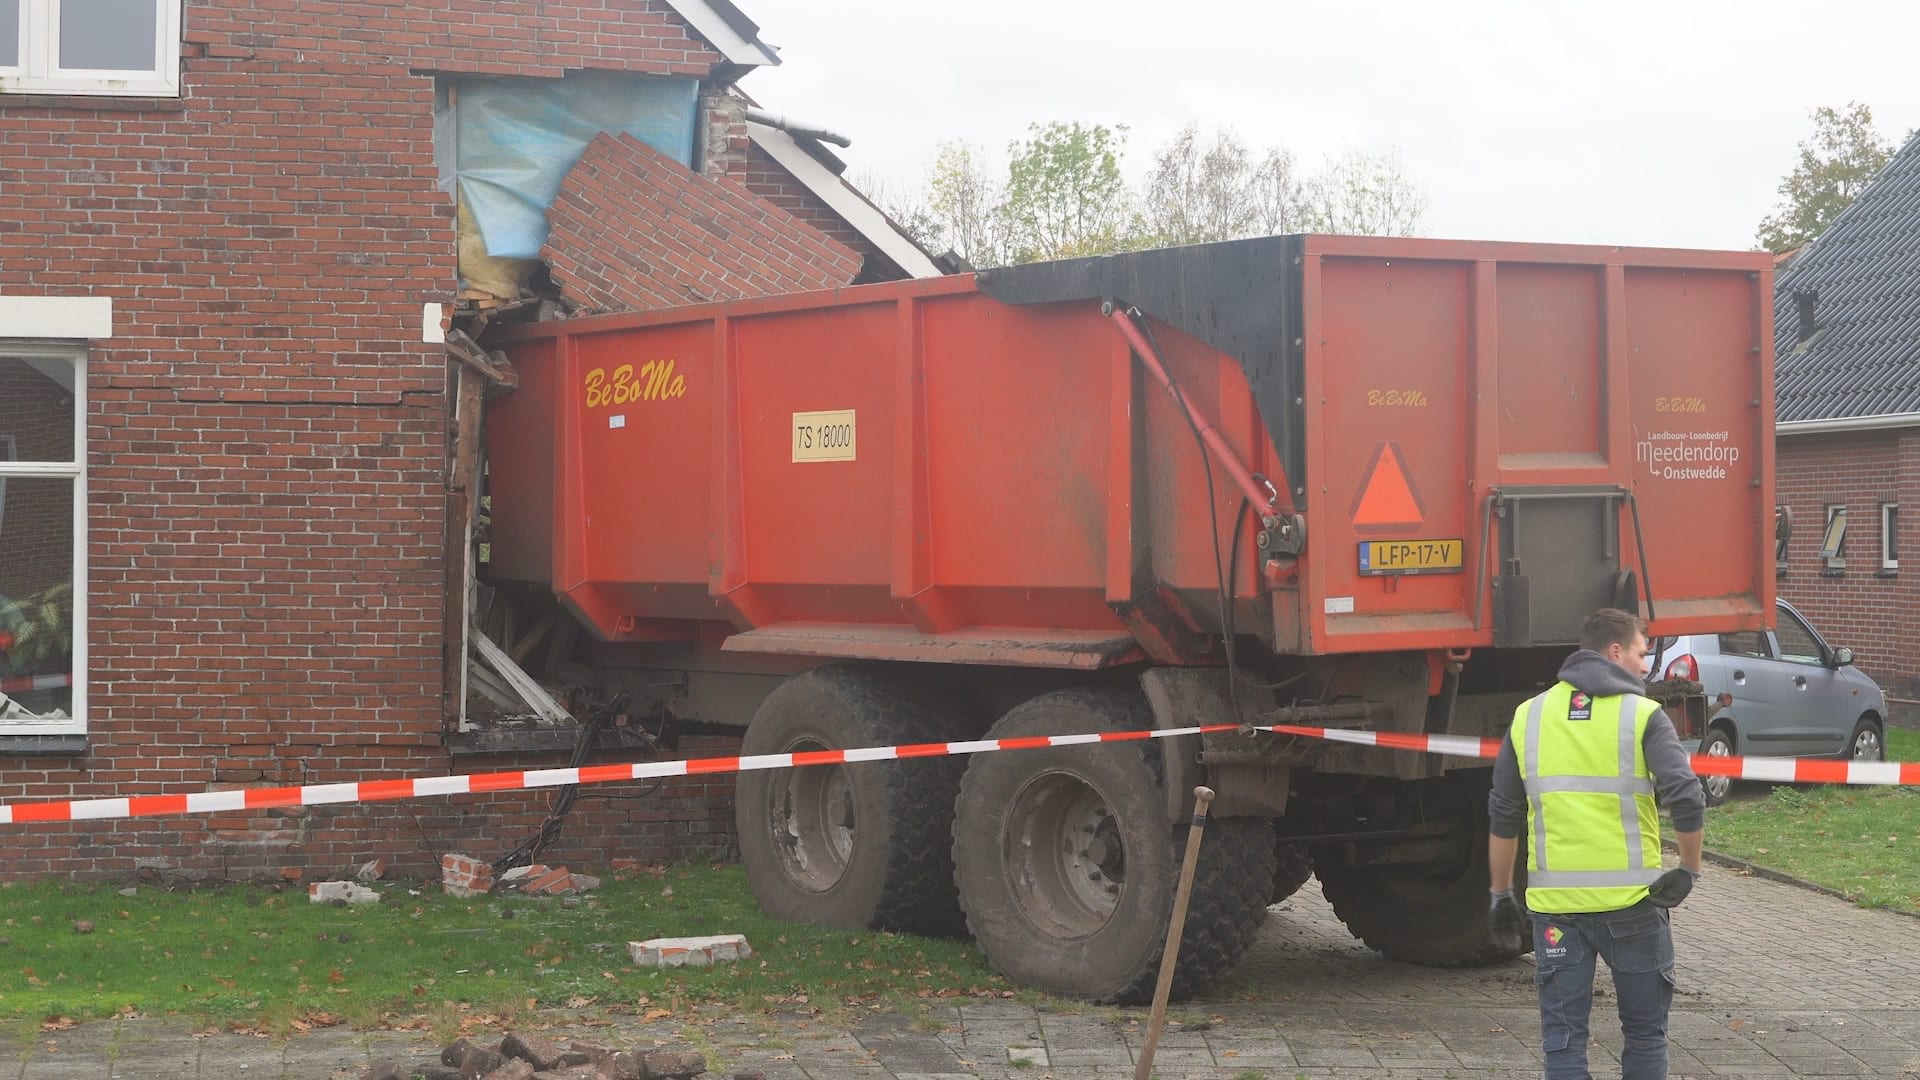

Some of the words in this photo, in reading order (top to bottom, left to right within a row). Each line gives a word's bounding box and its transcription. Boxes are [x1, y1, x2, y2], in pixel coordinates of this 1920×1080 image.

[584, 358, 687, 408] BeBoMa
[1367, 389, 1428, 407] BeBoMa
[1655, 396, 1707, 414] BeBoMa
[797, 425, 813, 449] TS
[817, 424, 851, 449] 18000
[1637, 440, 1739, 467] Meedendorp
[1663, 465, 1726, 480] Onstwedde
[1378, 543, 1450, 566] LFP-17-V
